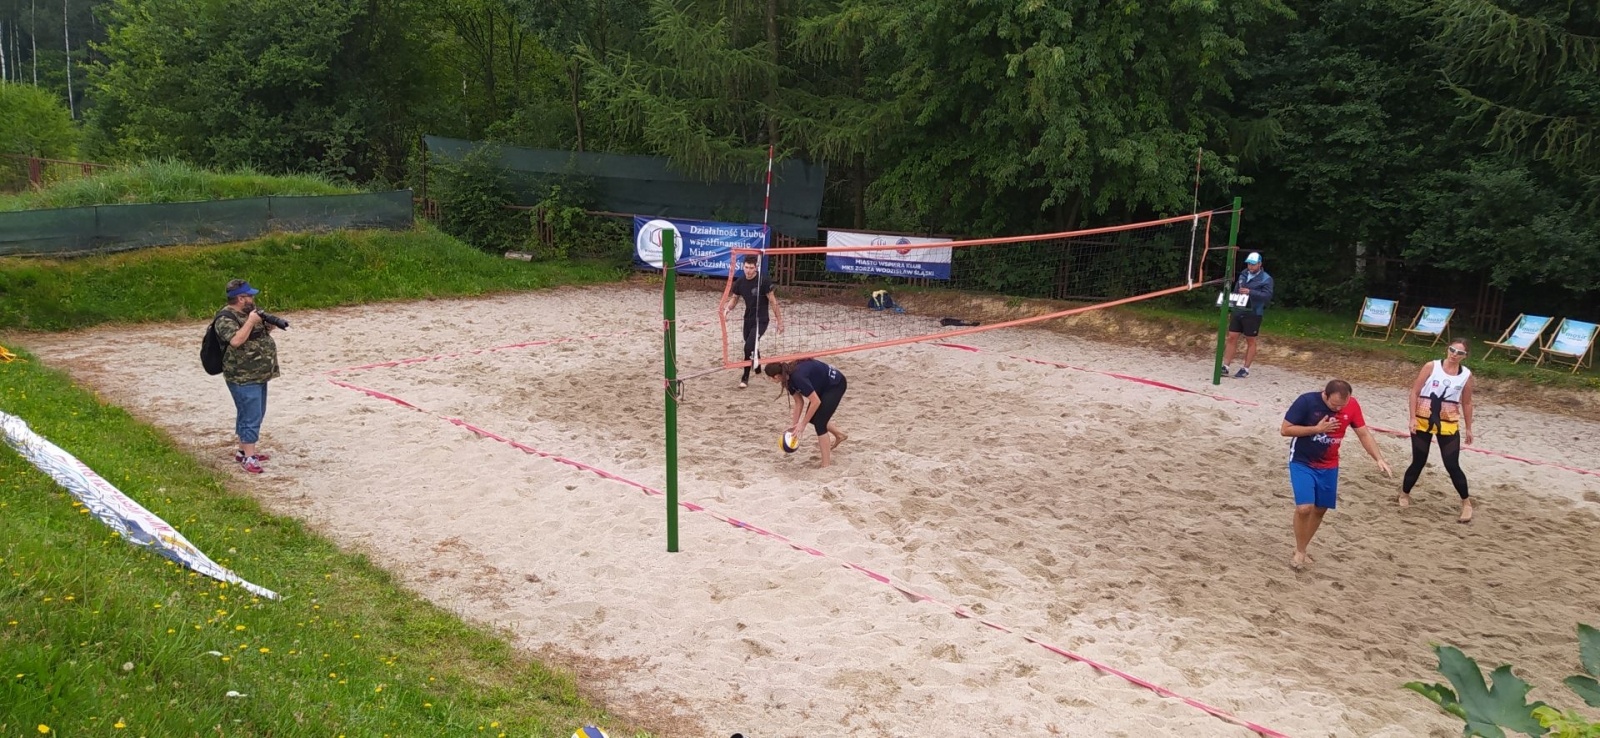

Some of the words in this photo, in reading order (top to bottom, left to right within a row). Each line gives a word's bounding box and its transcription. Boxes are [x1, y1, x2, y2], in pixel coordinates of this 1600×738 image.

[690, 225, 738, 237] Działalność
[740, 229, 764, 238] klubu
[689, 248, 717, 257] Miasto
[689, 258, 732, 269] Wodzisław
[875, 267, 913, 275] WODZISŁAW
